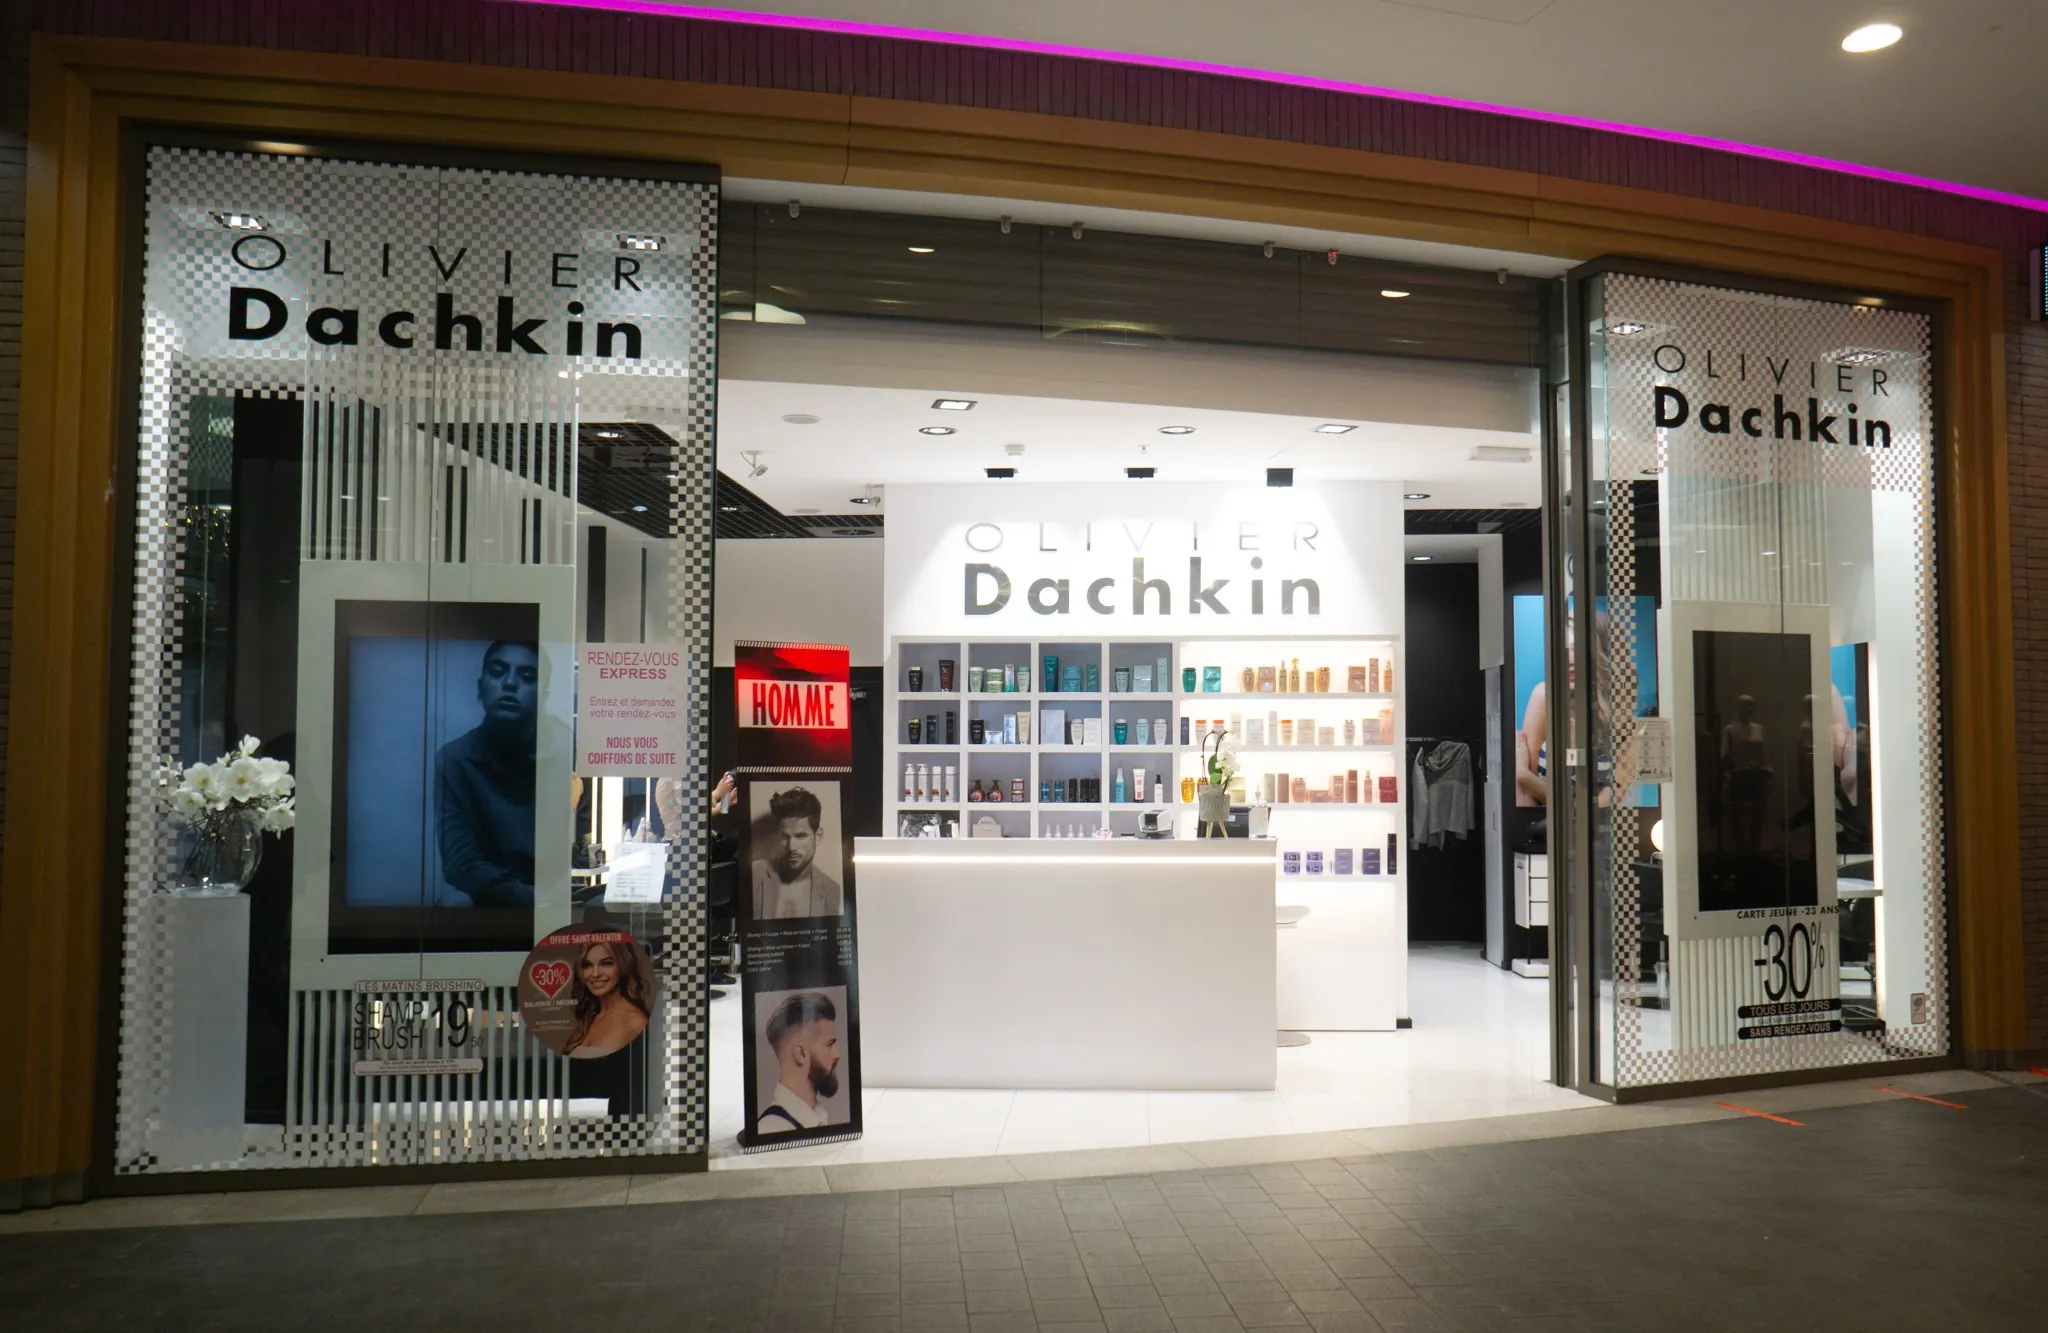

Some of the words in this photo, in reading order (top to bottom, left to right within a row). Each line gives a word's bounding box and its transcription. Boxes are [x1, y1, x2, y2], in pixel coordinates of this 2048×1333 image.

[231, 235, 642, 292] OLIVIER
[228, 286, 642, 360] Dachkin
[1653, 344, 1889, 397] OLIVIER
[1654, 385, 1891, 448] Dachkin
[965, 522, 1319, 552] OLIVIER
[964, 556, 1320, 615] Dachkin
[587, 651, 679, 667] RENDEZ-VOUS
[600, 668, 667, 680] EXPRESS
[589, 696, 617, 707] Entrez
[620, 697, 629, 707] et
[631, 697, 676, 707] demandez
[752, 683, 835, 726] HOMME
[589, 709, 614, 719] votre
[617, 709, 676, 719] rendez-vous
[606, 737, 631, 748] NOUS
[634, 737, 658, 748] VOUS
[588, 752, 633, 764] COIFFONS
[635, 752, 647, 764] DE
[649, 752, 676, 764] SUITE
[1737, 910, 1766, 919] CARTE
[1769, 908, 1798, 918] JEUNE
[1801, 907, 1817, 916] -23
[1820, 905, 1839, 914] ANS
[549, 935, 570, 945] OFFRE
[571, 932, 622, 944] SAINT-VALENTIN
[1754, 921, 1825, 1001] -30%
[535, 968, 566, 986] -30%
[358, 981, 378, 992] LES
[382, 981, 420, 991] MATINS
[426, 980, 482, 990] BRUSHING
[354, 1001, 424, 1025] SHAMP
[1750, 1005, 1776, 1017] TOUS
[1779, 1003, 1796, 1014] LES
[1799, 1000, 1830, 1011] JOURS
[431, 1000, 469, 1048] 19
[1749, 1028, 1772, 1038] SANS
[1774, 1022, 1831, 1035] RENDEZ-VOUS
[354, 1026, 423, 1050] BRUSH
[471, 1036, 483, 1048] 50
